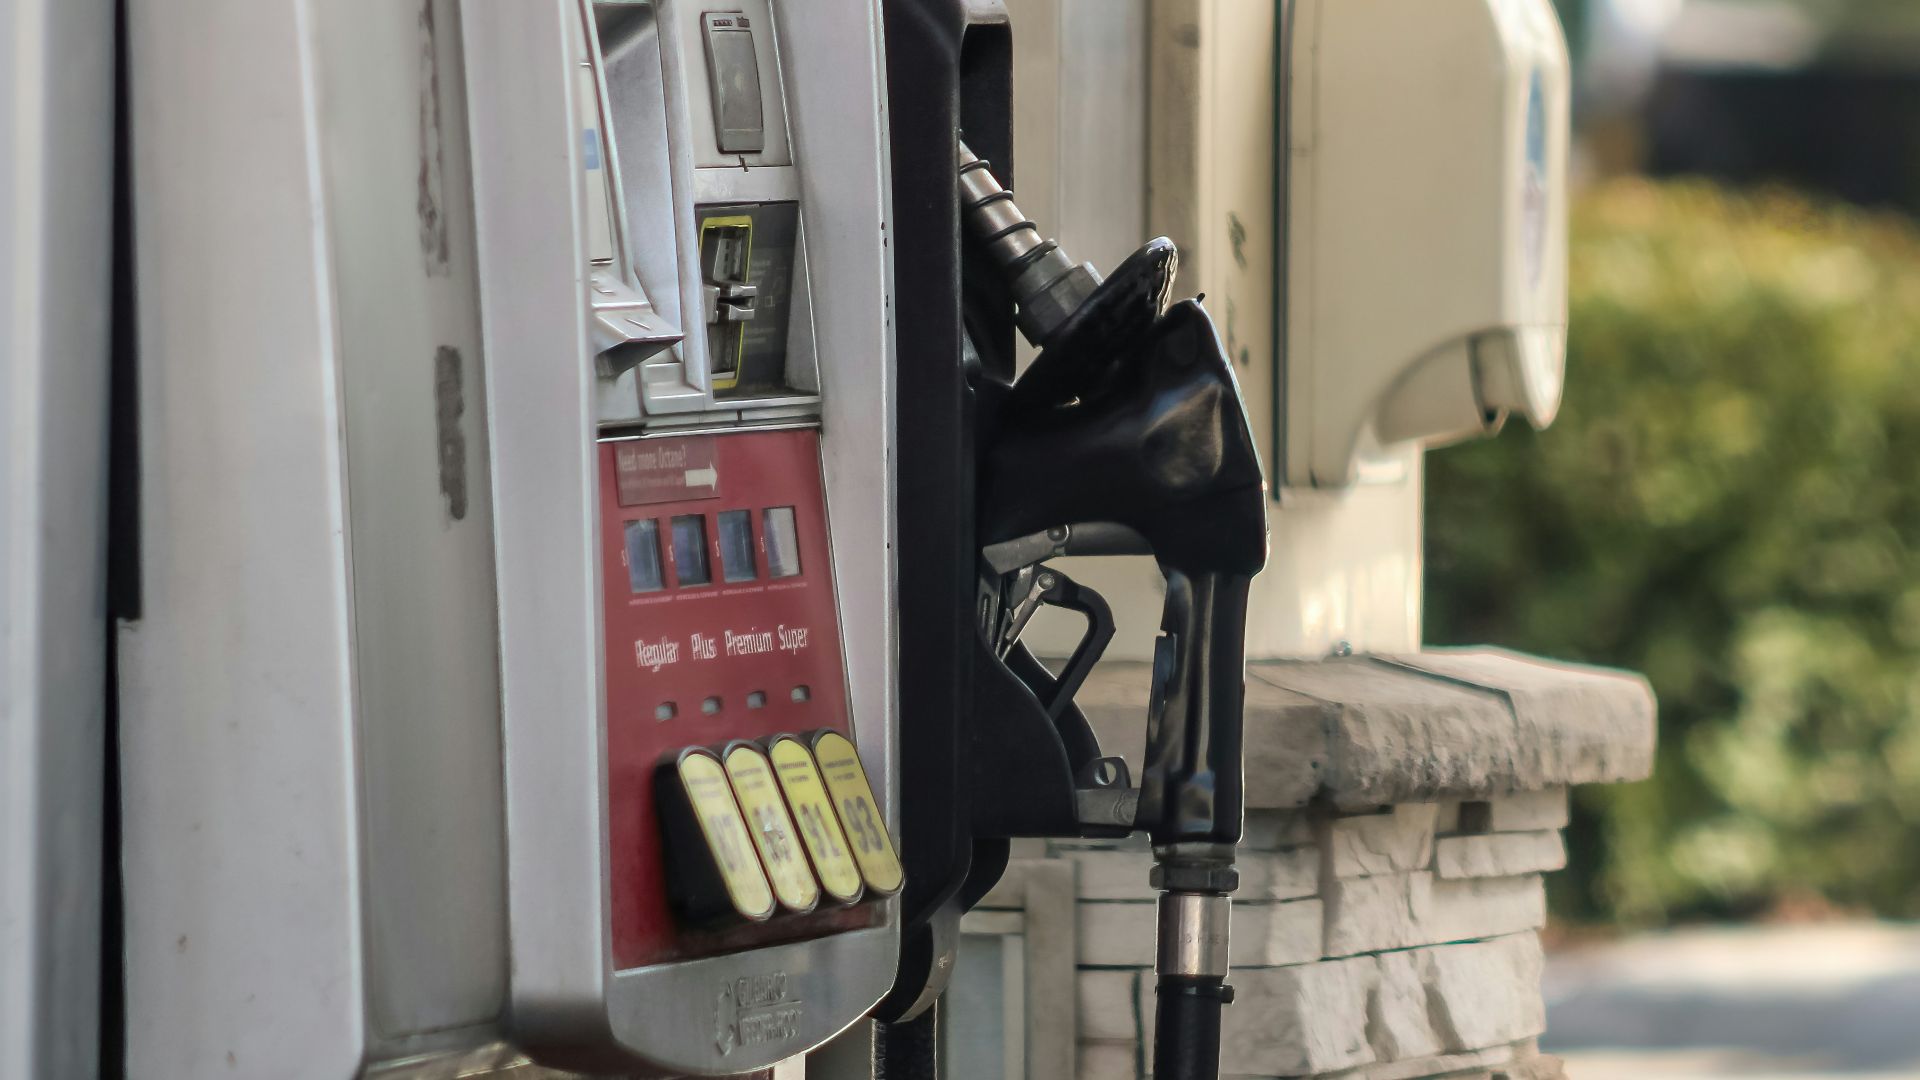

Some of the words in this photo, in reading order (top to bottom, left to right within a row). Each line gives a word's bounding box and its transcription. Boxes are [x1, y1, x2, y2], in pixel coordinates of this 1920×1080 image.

[635, 636, 680, 673] Regular
[691, 632, 718, 662] Plus
[724, 626, 774, 656] Premium
[778, 624, 809, 656] Super
[800, 803, 841, 860] 91
[843, 795, 883, 855] 93
